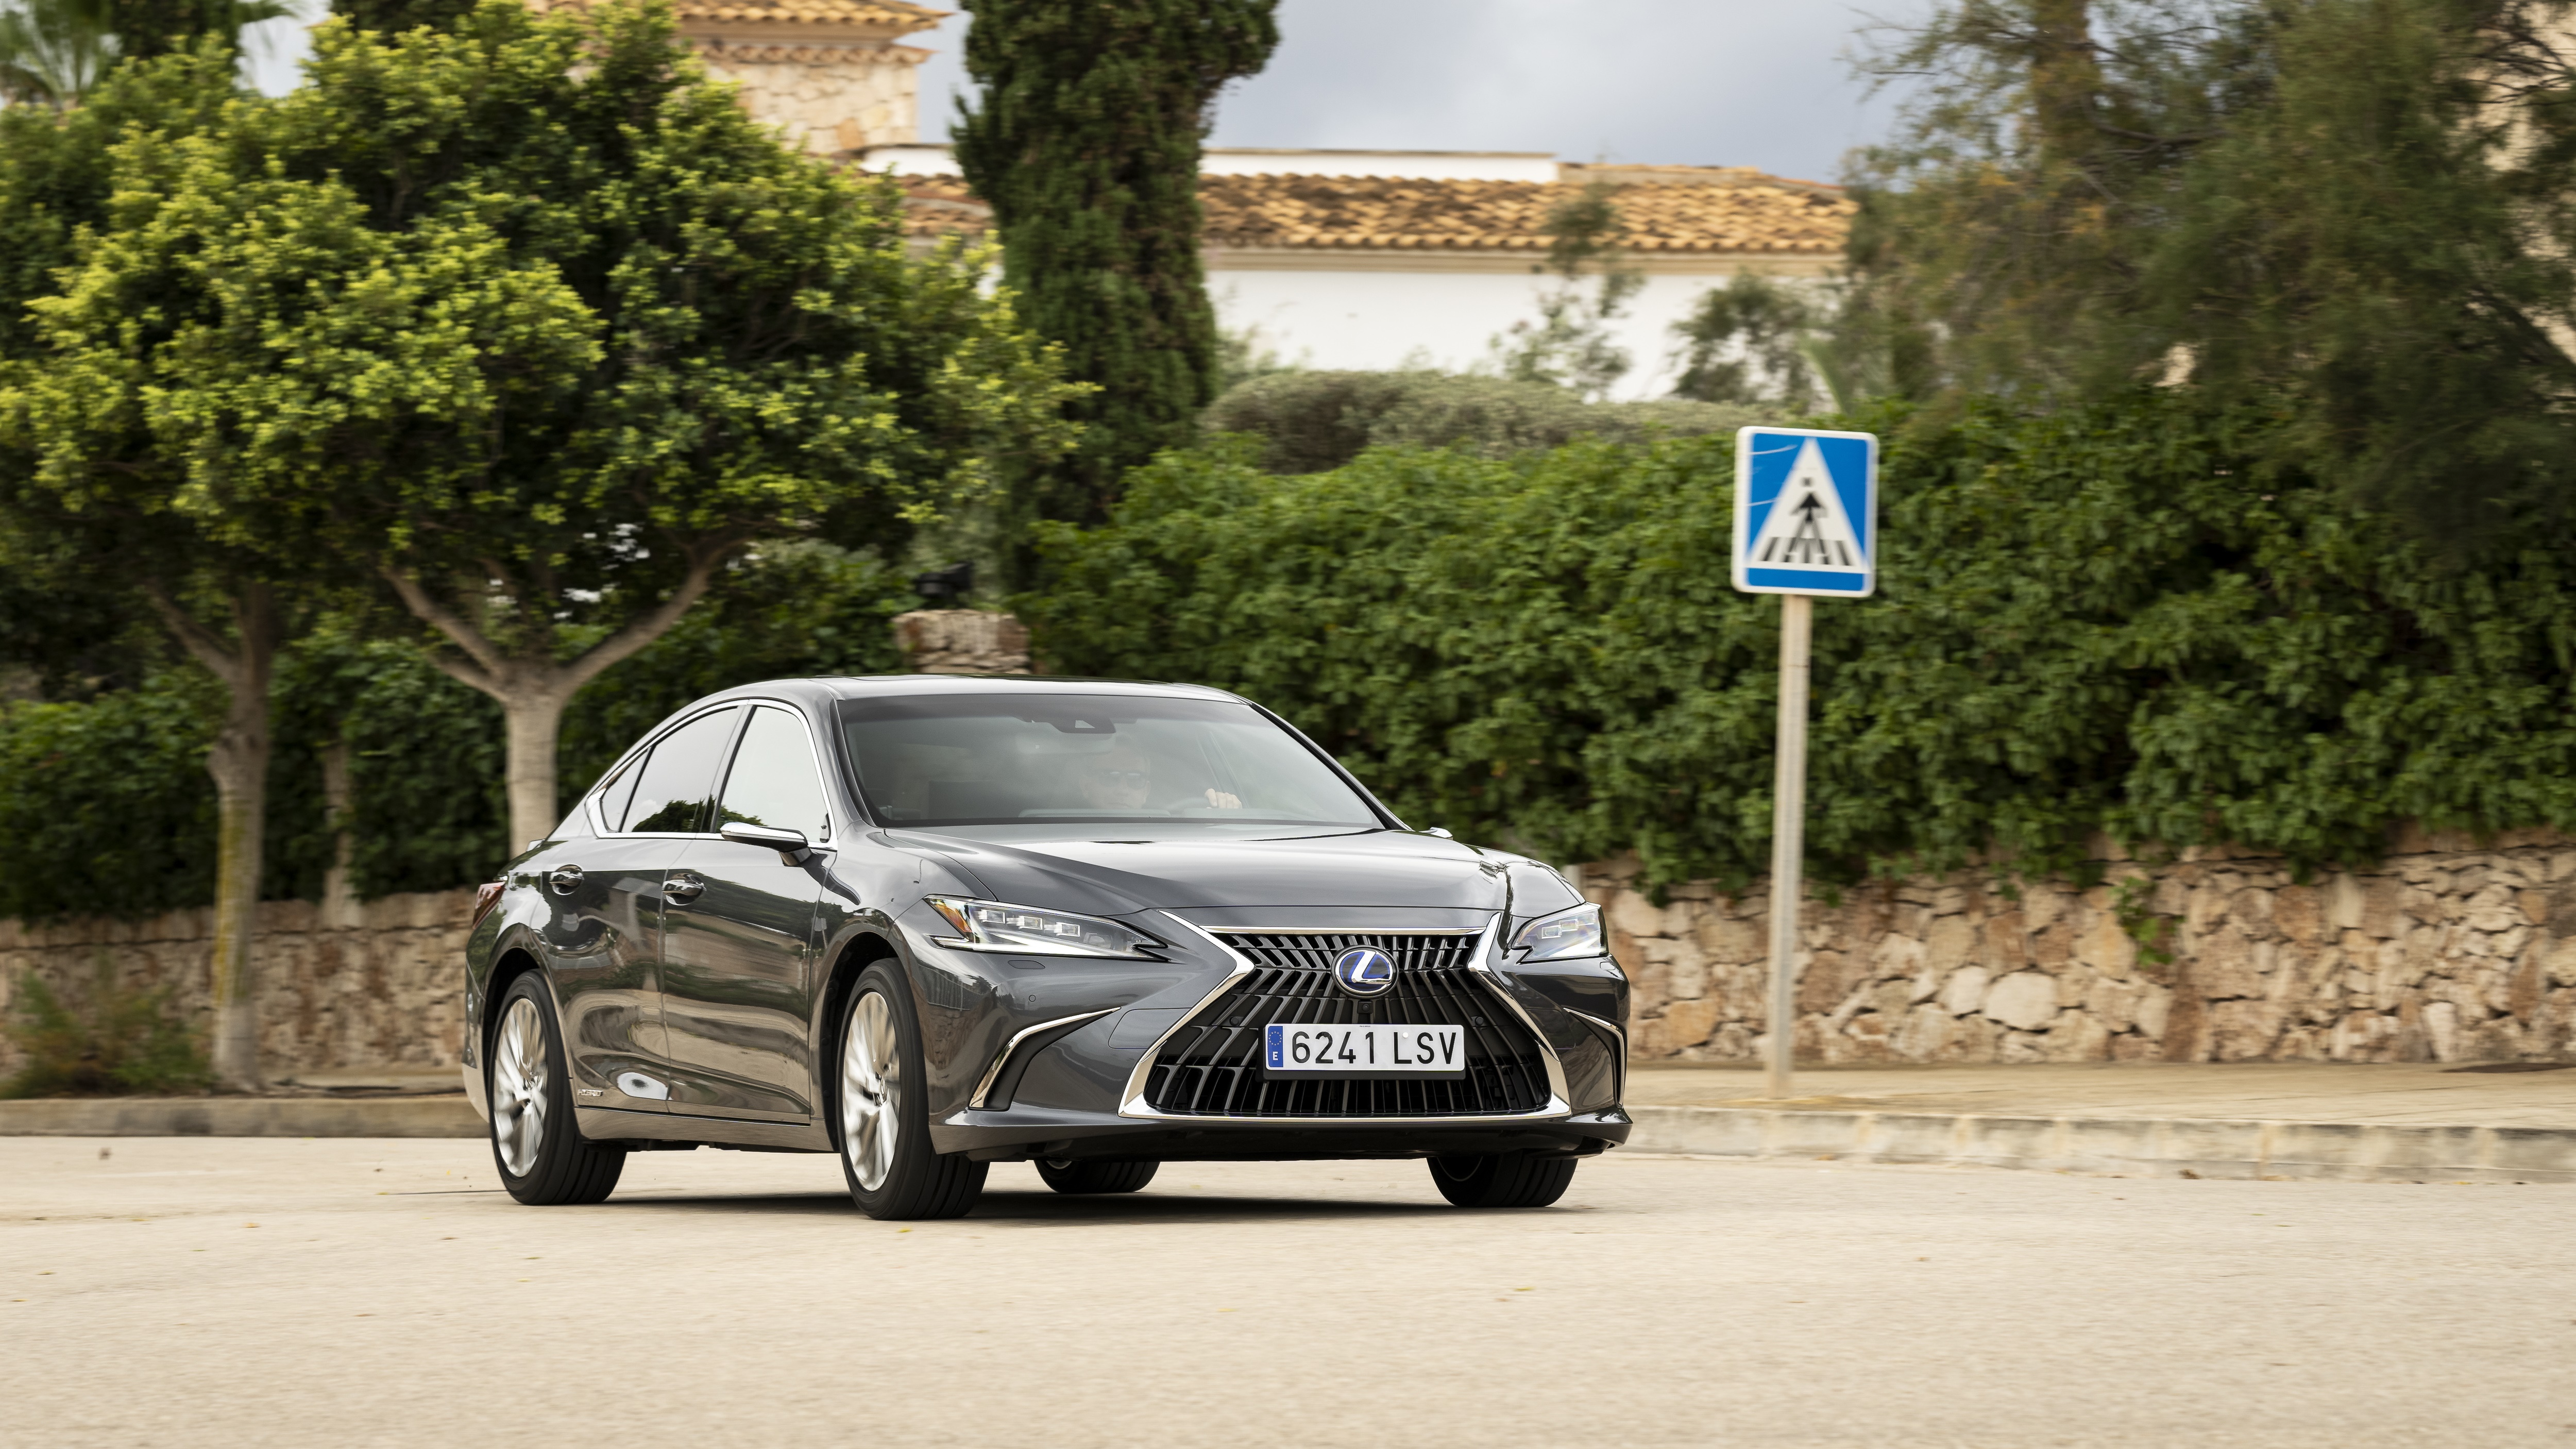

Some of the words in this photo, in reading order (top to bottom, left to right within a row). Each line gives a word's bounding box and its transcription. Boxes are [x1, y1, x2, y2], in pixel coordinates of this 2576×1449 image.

[1273, 1051, 1278, 1060] E
[1292, 1031, 1375, 1064] 6241
[1394, 1032, 1456, 1065] LSV
